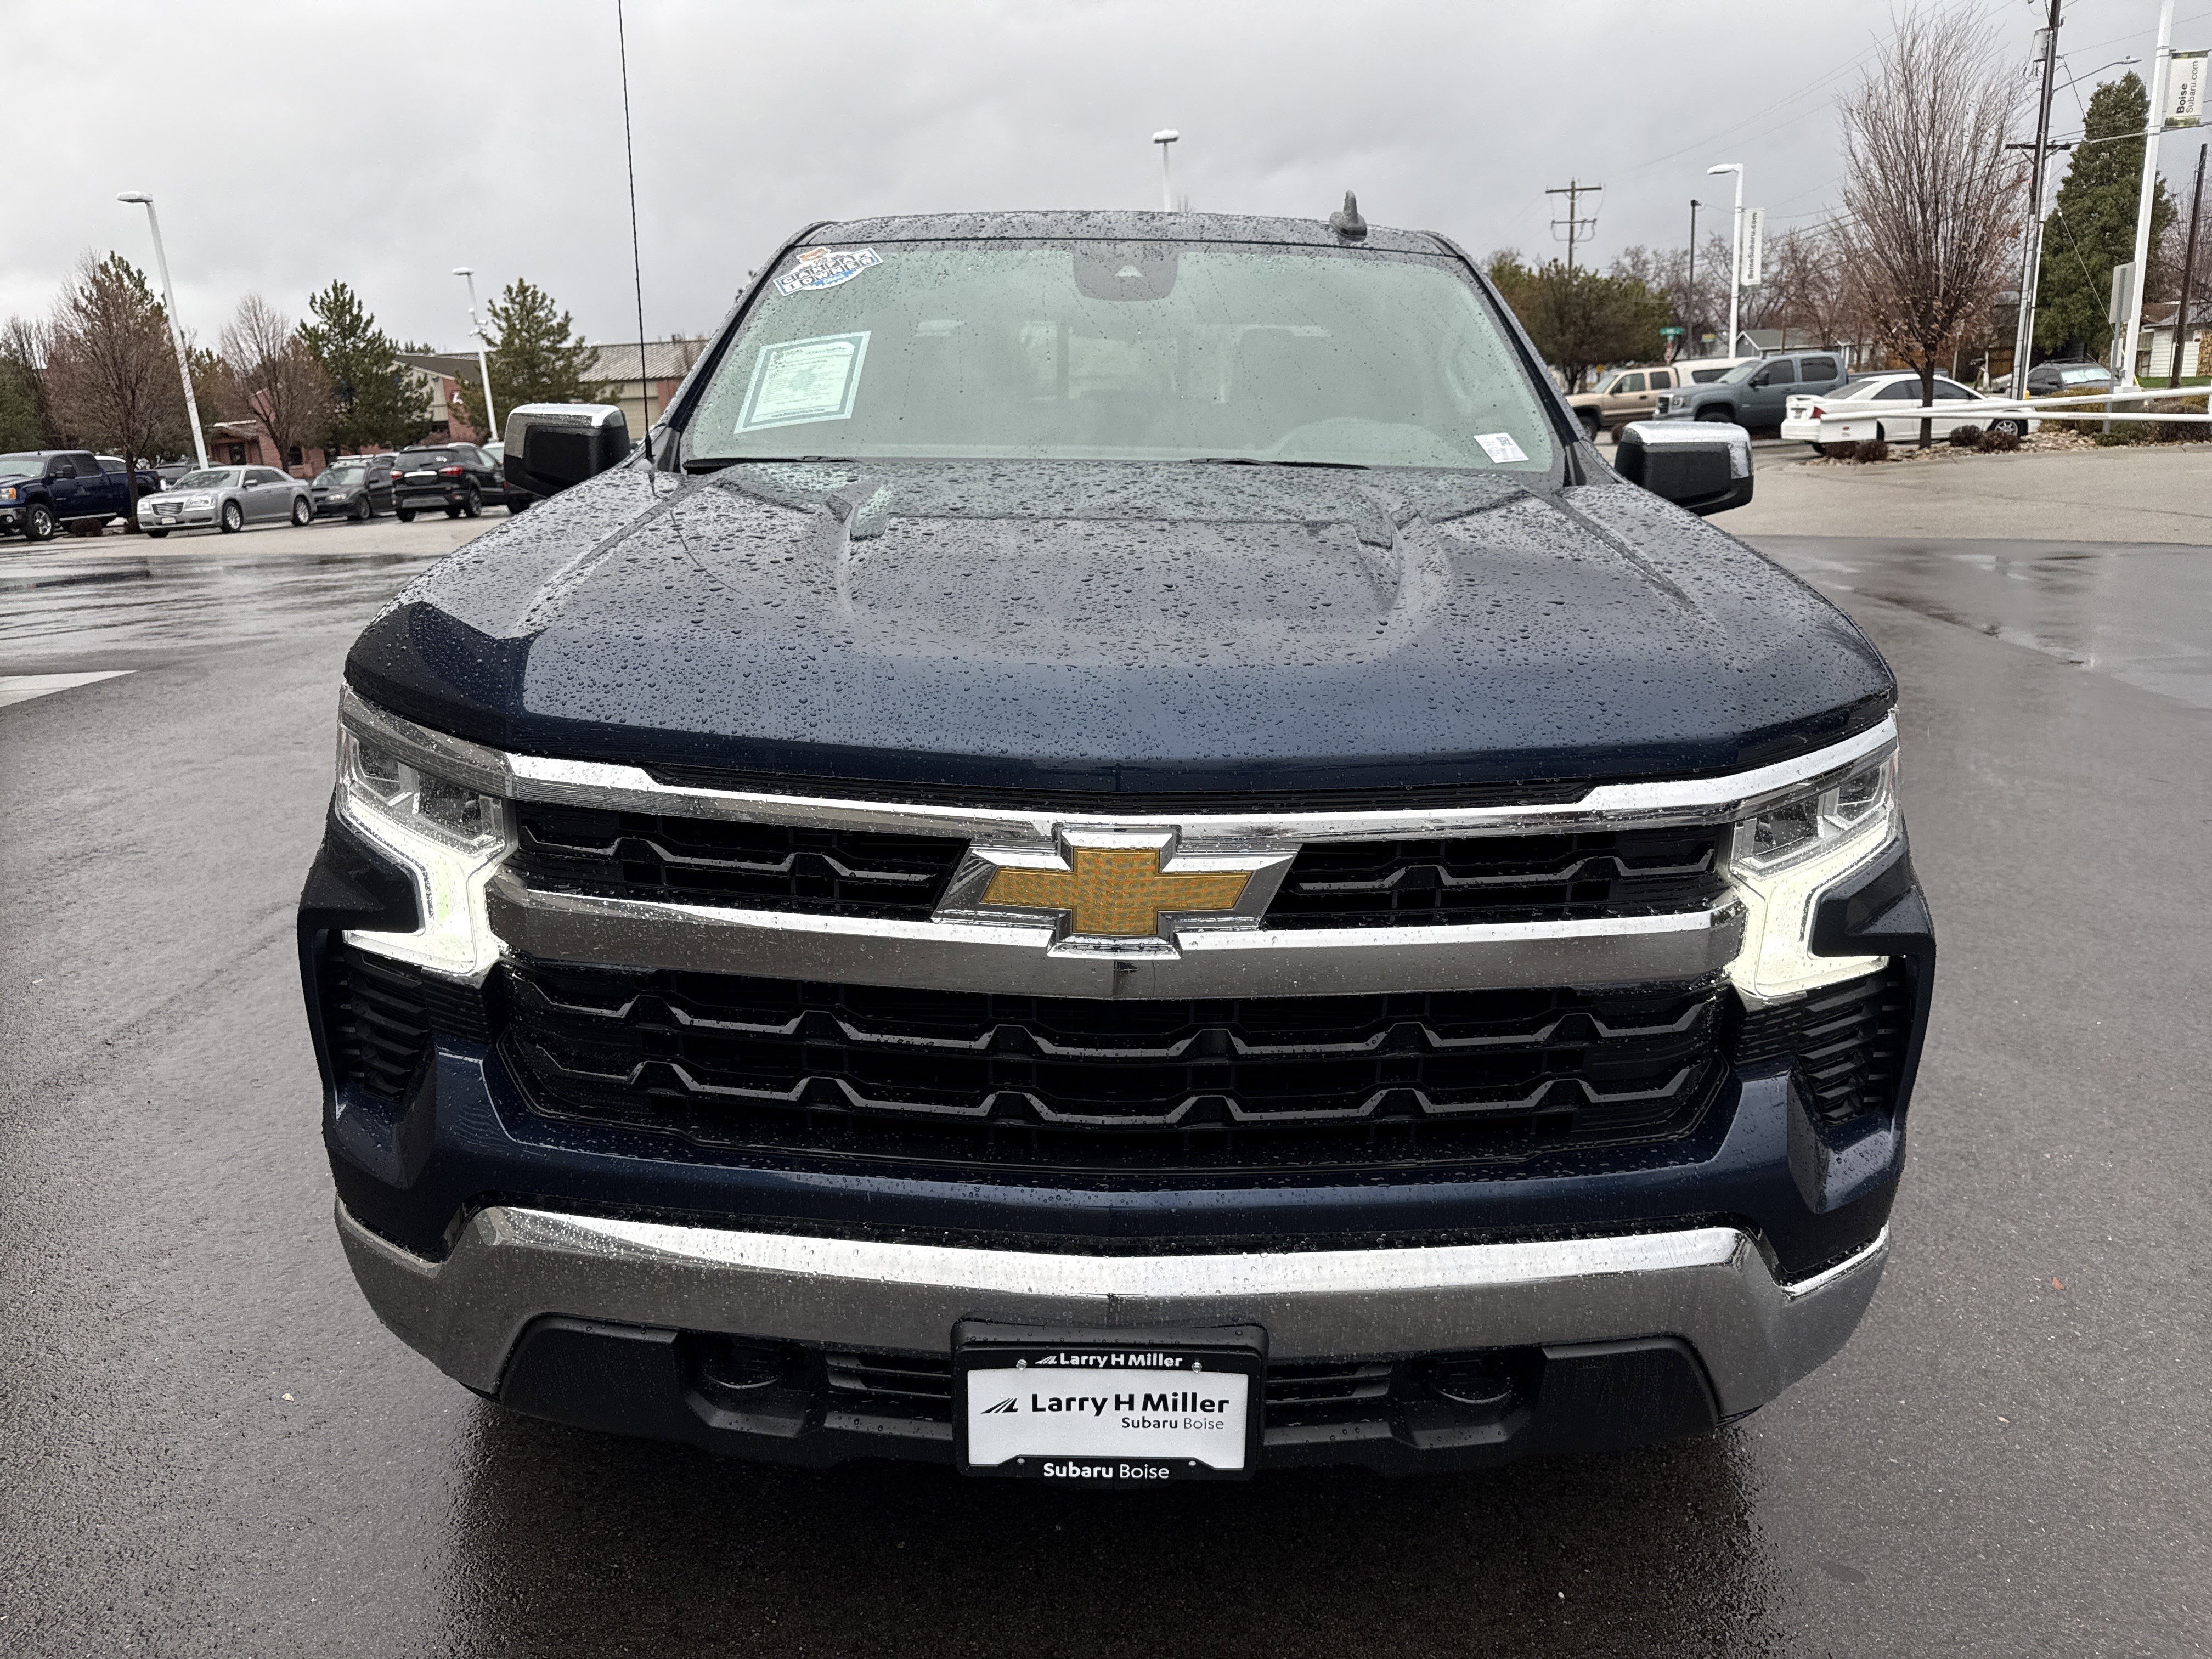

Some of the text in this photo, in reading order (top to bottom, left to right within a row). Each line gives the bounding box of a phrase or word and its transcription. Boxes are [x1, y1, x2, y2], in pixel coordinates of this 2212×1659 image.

[2176, 83, 2187, 114] Boise
[2186, 61, 2198, 114] Subaru.com
[782, 253, 868, 284] CARFAX
[801, 258, 873, 285] OWNER
[1060, 1352, 1183, 1367] Larry H Miller
[1031, 1392, 1229, 1417] Larry H Miller
[1121, 1417, 1224, 1430] Subaru Boise
[1043, 1462, 1170, 1479] Subaru Boise
